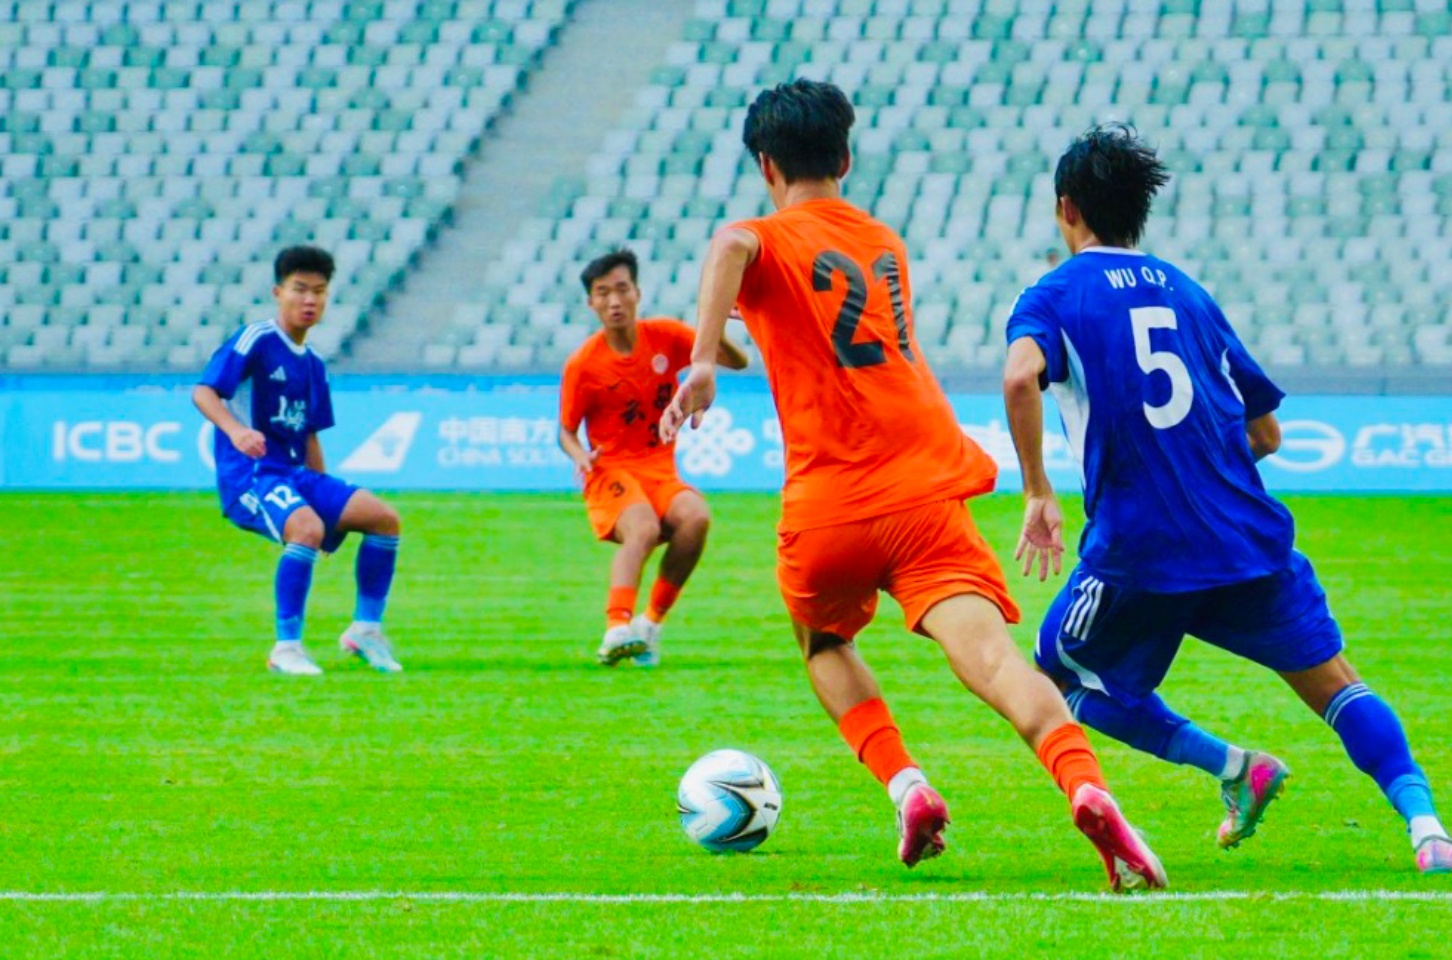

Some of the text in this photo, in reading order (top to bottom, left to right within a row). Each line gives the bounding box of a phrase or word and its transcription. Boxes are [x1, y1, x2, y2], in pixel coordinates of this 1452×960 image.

[1104, 266, 1175, 291] WU Q.P.
[812, 250, 917, 369] 21
[1129, 306, 1194, 429] 5
[52, 420, 181, 462] ICBC
[1352, 449, 1421, 467] GAC
[264, 485, 302, 511] 12
[608, 480, 625, 498] 3
